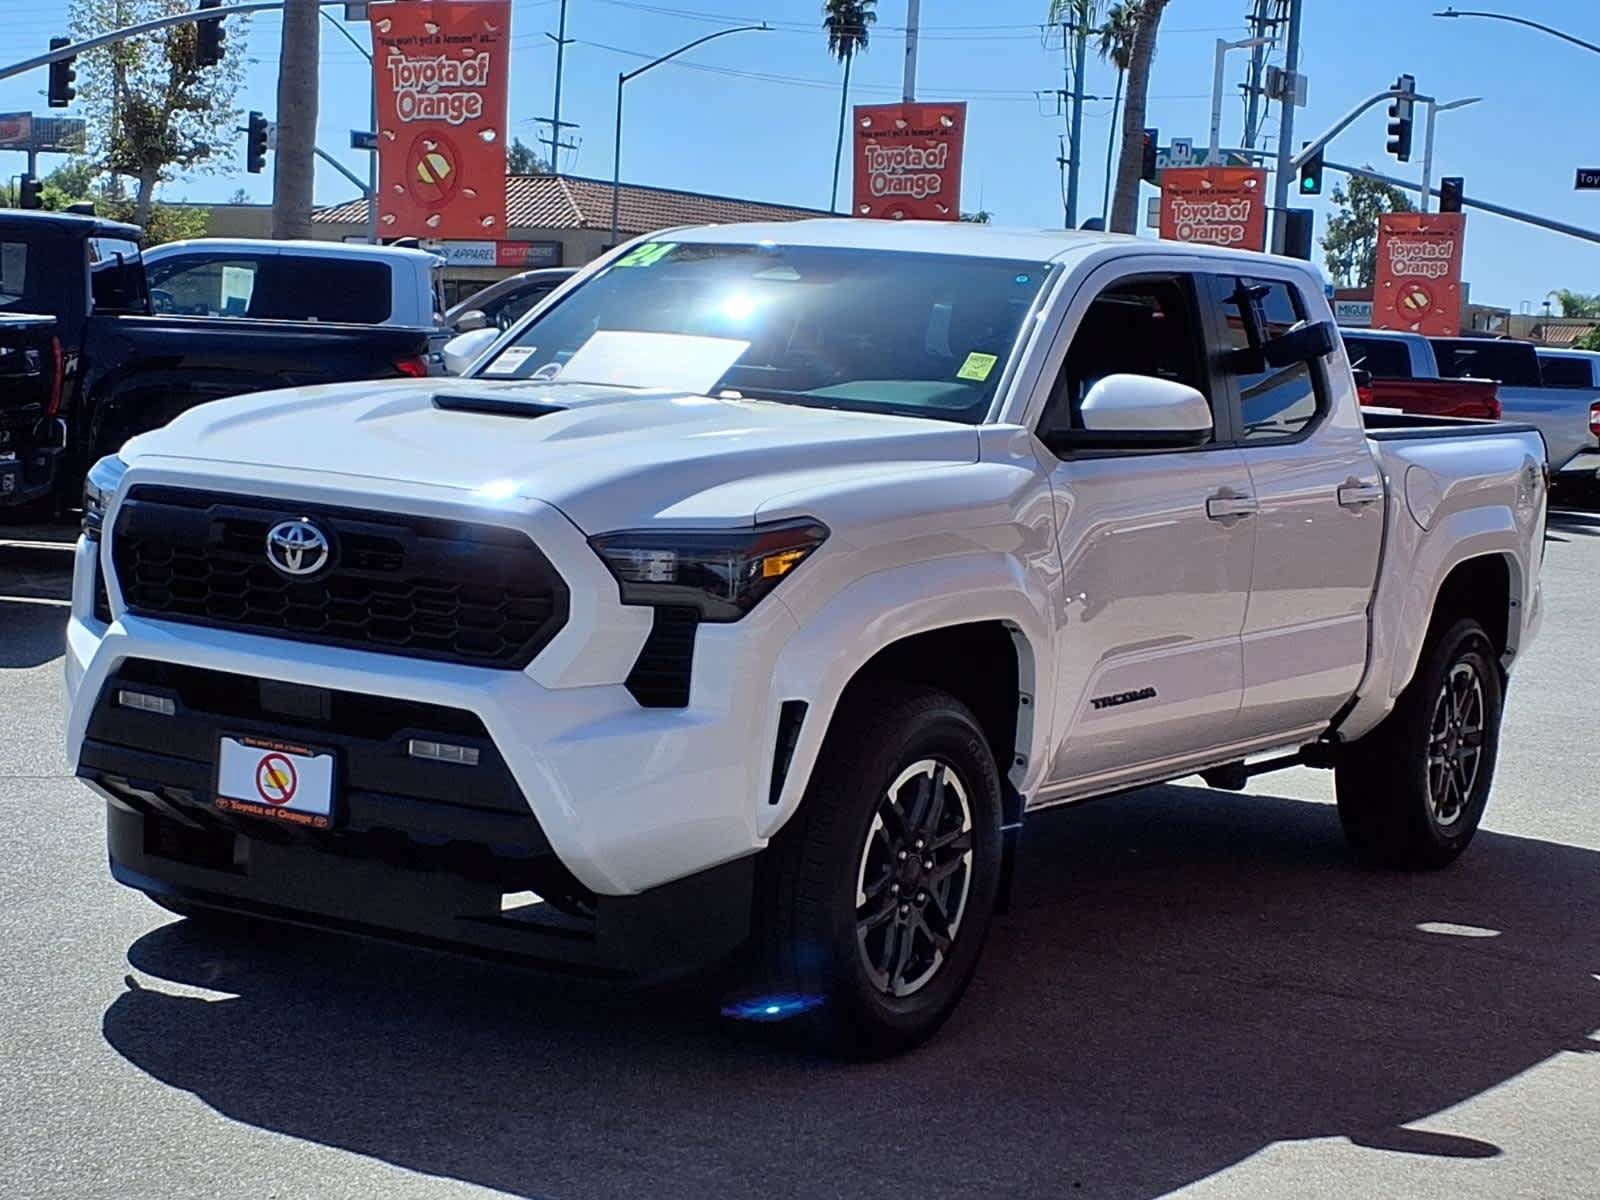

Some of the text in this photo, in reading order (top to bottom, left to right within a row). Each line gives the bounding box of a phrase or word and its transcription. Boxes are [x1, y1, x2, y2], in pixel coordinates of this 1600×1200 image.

[387, 52, 490, 91] Toyota of
[397, 91, 483, 125] Orange
[865, 143, 948, 173] Toyota of
[871, 172, 942, 199] Orange
[1171, 200, 1251, 224] Toyota of
[1177, 223, 1245, 244] Orange
[453, 247, 495, 260] APPAREL
[1387, 240, 1454, 260] Toyota of
[1391, 260, 1449, 278] Orange
[1090, 687, 1157, 710] TACOMA
[230, 801, 313, 825] Toyota of Orange
